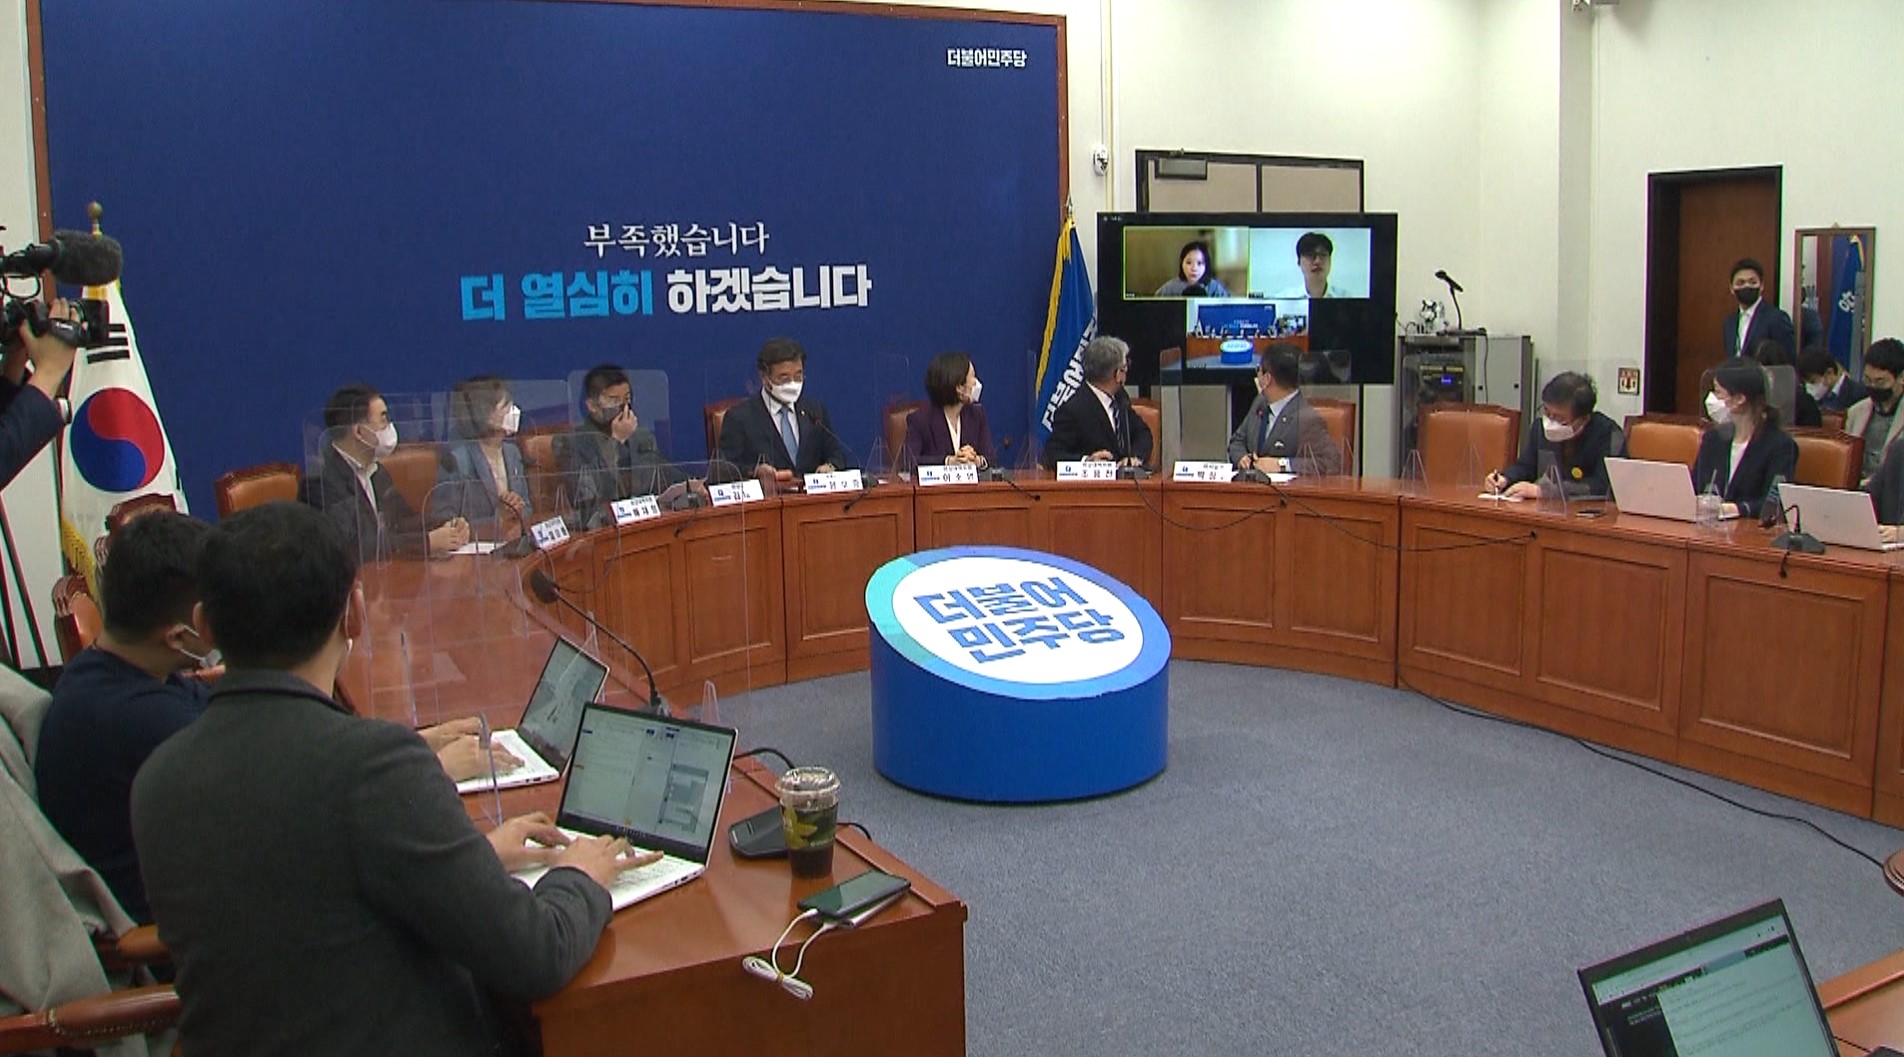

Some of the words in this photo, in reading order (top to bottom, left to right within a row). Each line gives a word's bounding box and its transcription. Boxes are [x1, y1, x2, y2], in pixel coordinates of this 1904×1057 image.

[947, 48, 1027, 67] 더불어민주당
[584, 222, 770, 258] 부족했습니다
[460, 274, 506, 321] 더
[521, 269, 654, 320] 열심히
[667, 263, 872, 315] 하겠습니다
[913, 577, 1088, 624] 더불어
[948, 608, 1125, 664] 민주당
